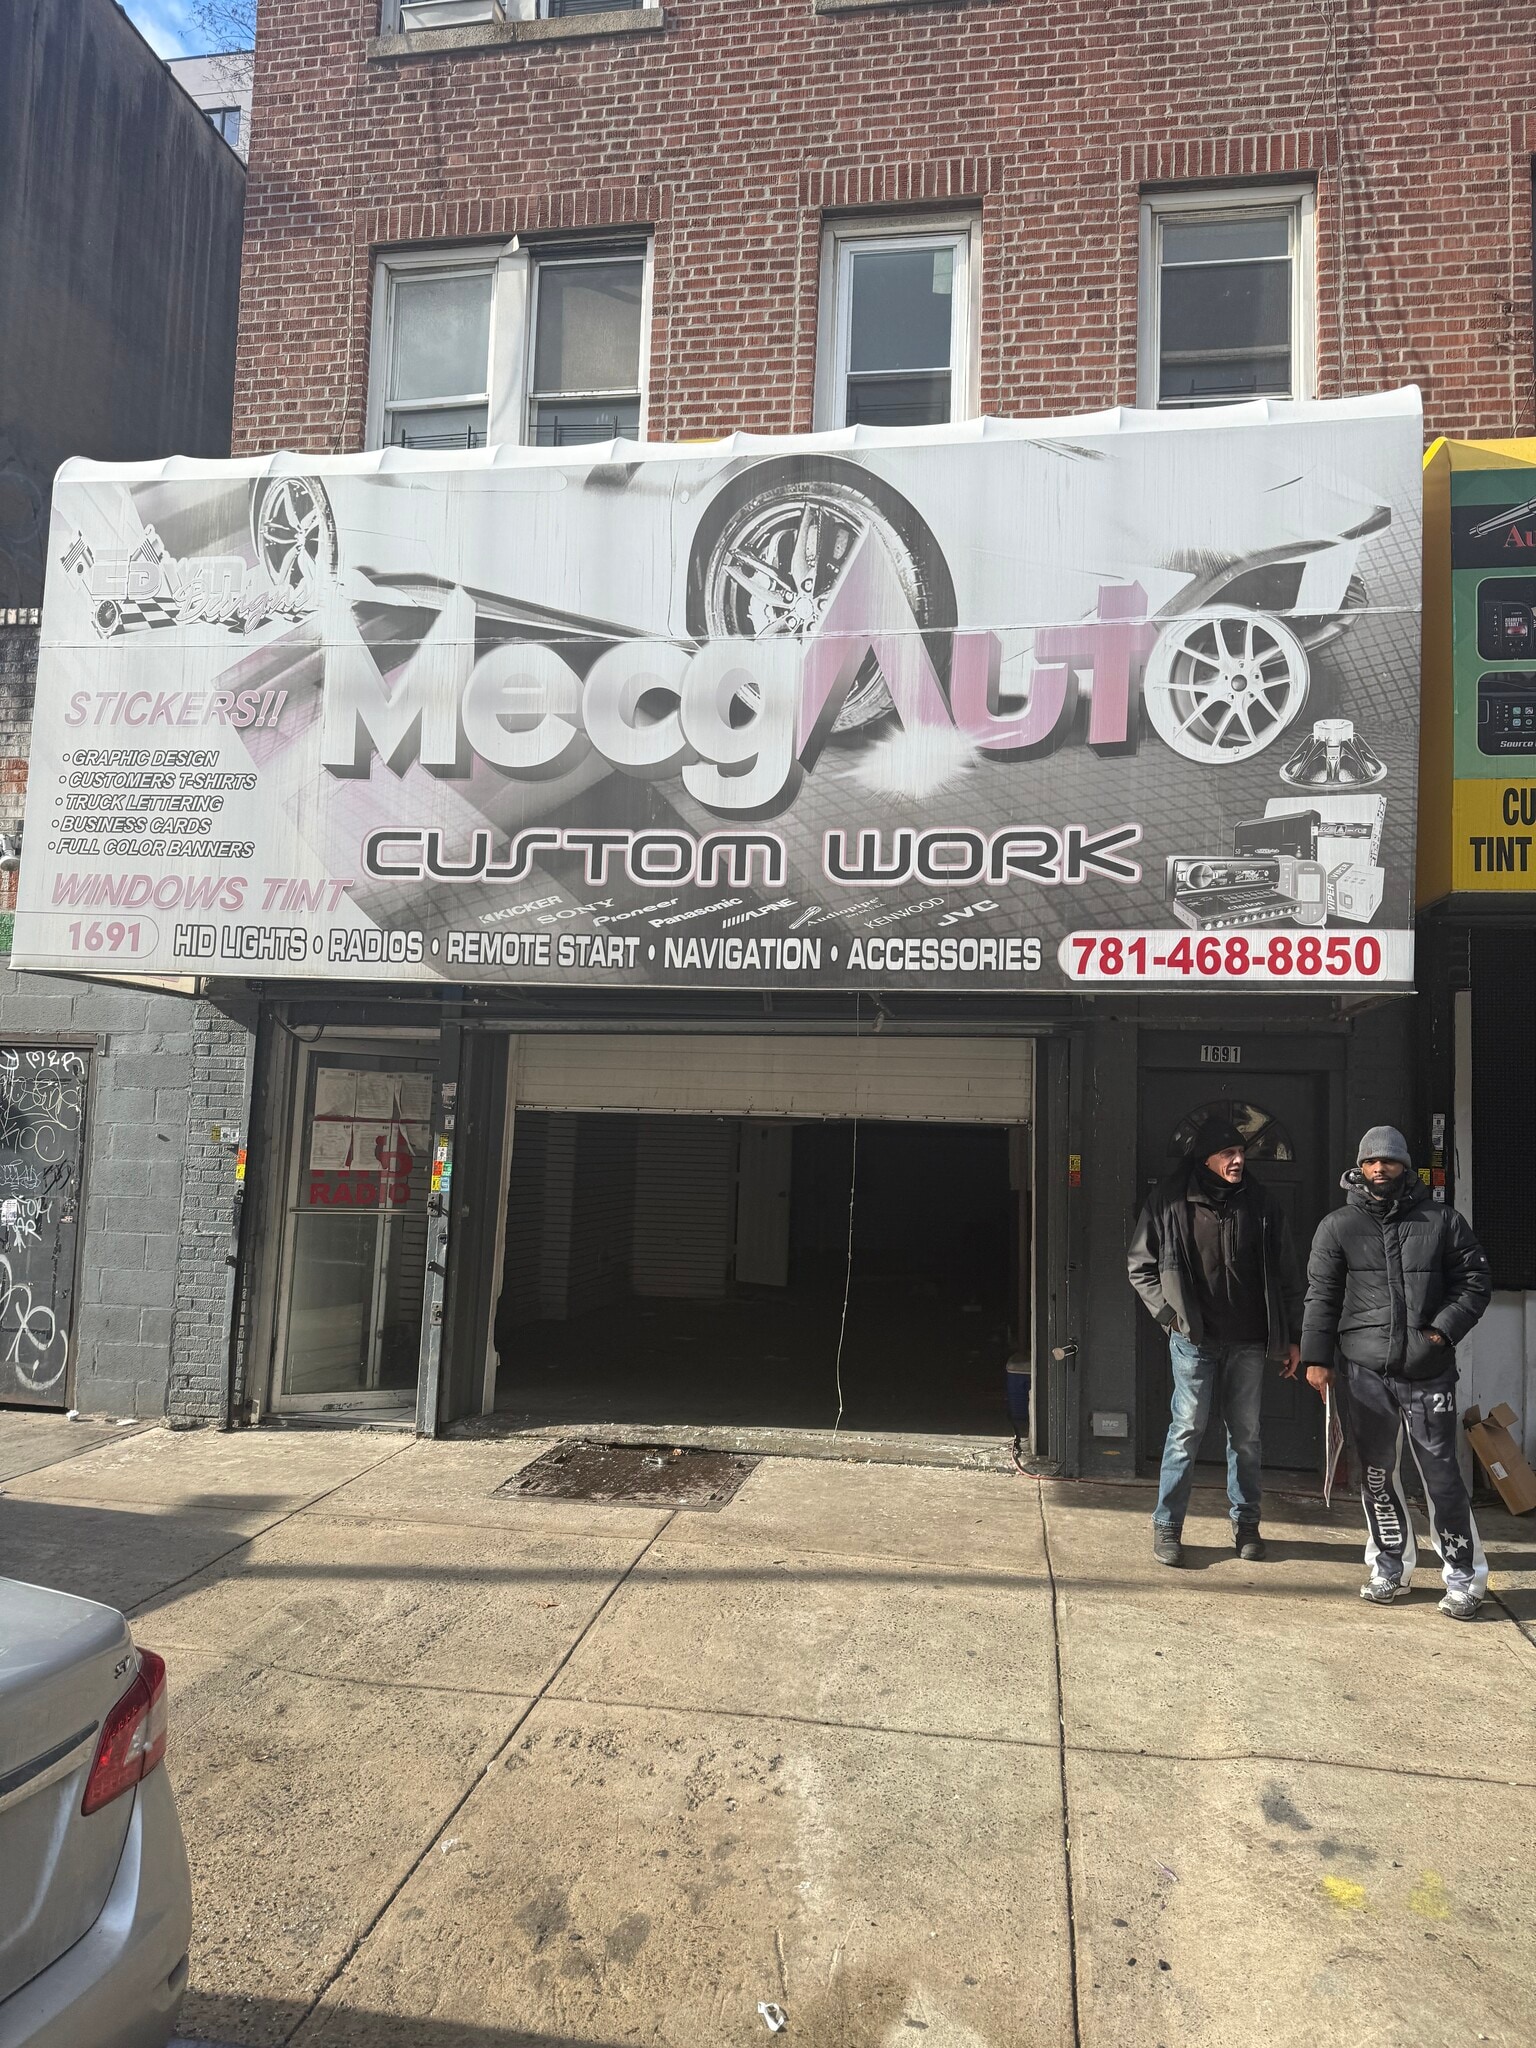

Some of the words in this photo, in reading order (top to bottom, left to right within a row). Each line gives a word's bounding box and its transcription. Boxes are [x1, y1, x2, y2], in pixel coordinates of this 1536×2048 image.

[65, 690, 288, 727] STICKERS!!
[72, 749, 150, 766] GRAPHIC
[151, 751, 219, 767] DESIGN
[1500, 740, 1534, 748] Source
[68, 772, 175, 789] CUSTOMERS
[179, 773, 257, 790] T-SHIRTS
[66, 794, 126, 811] TRUCK
[126, 795, 224, 812] LETTERING
[60, 816, 147, 833] BUSINESS
[150, 817, 212, 834] CARDS
[57, 839, 100, 855] FULL
[104, 839, 165, 857] COLOR
[167, 840, 255, 858] BANNERS
[364, 828, 786, 888] CUSTOM
[823, 822, 1144, 885] WORK
[1470, 836, 1532, 872] TINT
[51, 873, 248, 911] WINDOWS
[261, 878, 355, 913] TINT
[1327, 883, 1335, 911] VIPER
[492, 895, 564, 921] KICKER
[537, 898, 615, 925] SONY
[593, 897, 679, 927] Pioneer
[648, 897, 743, 928] Panasonic
[807, 897, 879, 927] Audiopipe
[864, 897, 945, 929] KENWOOD
[938, 900, 999, 926] JVC
[68, 921, 141, 952] 1691
[174, 924, 217, 958] HID
[220, 926, 307, 961] LIGHTS
[328, 928, 424, 963] RADIOS
[447, 930, 552, 965] REMOTE
[557, 933, 641, 968] START
[663, 936, 822, 970] NAVIGATION
[846, 937, 1042, 971] ACCESSORIES
[1072, 936, 1382, 976] 781-468-8850
[1204, 1046, 1238, 1062] 1691
[309, 1182, 411, 1204] RADIO
[1374, 1503, 1403, 1545] CHILD
